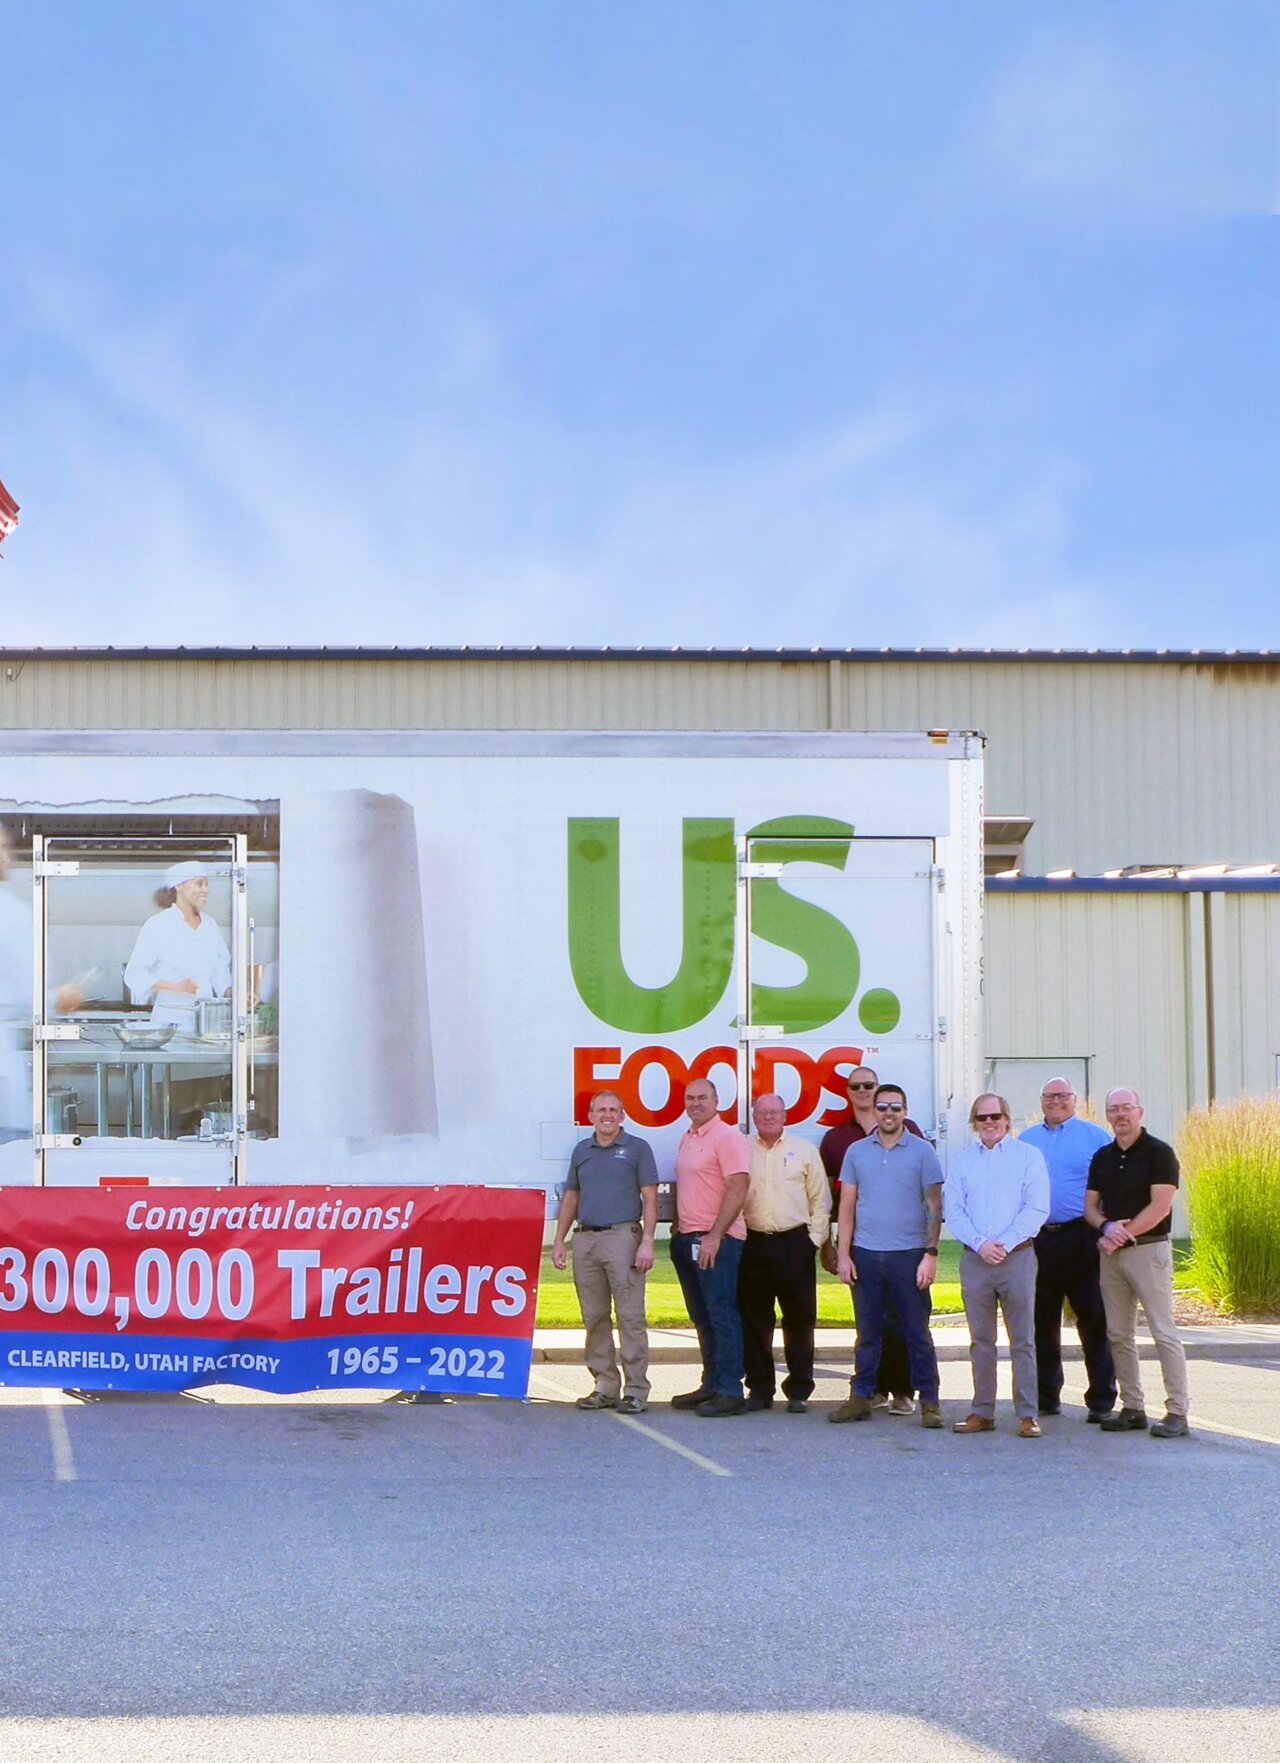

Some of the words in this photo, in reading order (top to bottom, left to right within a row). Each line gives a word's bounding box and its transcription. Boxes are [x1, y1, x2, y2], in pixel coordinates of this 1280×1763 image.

[573, 1045, 865, 1128] FOODS
[125, 1199, 415, 1238] Congratulations!
[277, 1246, 528, 1320] Trailers
[7, 1349, 130, 1372] CLEARFIELD,
[135, 1353, 188, 1372] UTAH
[193, 1353, 281, 1375] FACTORY
[327, 1346, 399, 1376] 1965
[428, 1347, 505, 1380] 2022
